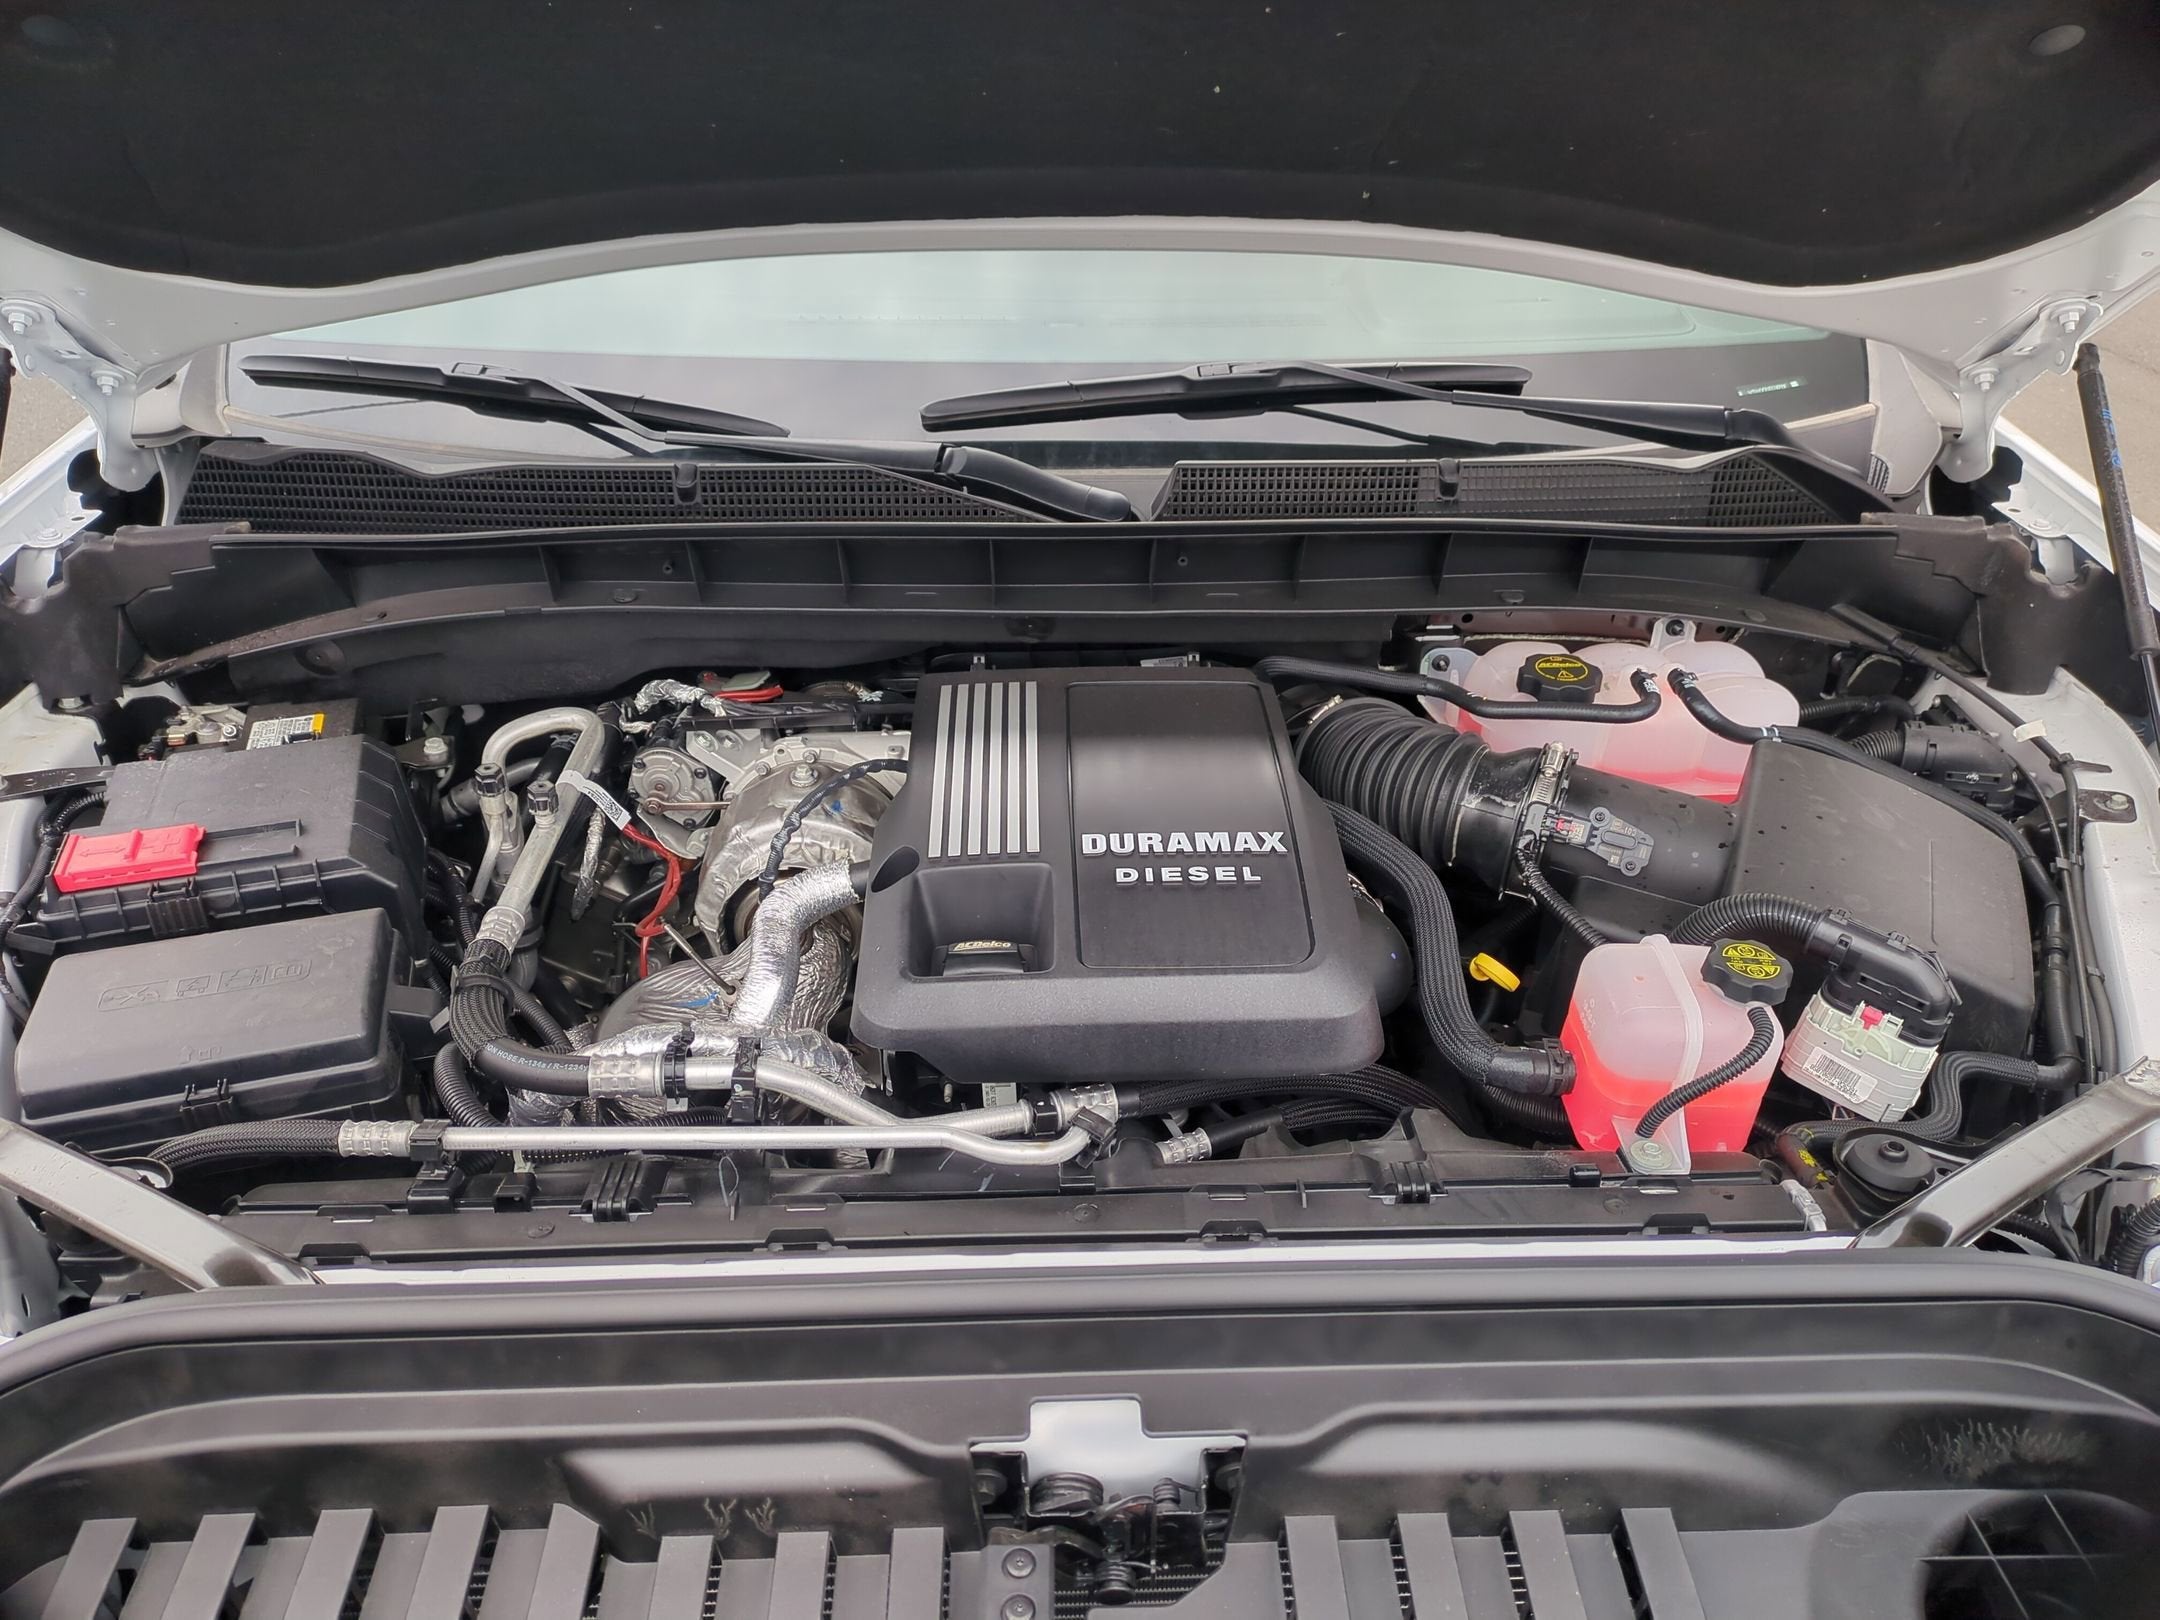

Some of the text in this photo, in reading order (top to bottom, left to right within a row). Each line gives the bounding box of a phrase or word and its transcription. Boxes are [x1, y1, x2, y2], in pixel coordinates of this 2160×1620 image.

[1081, 831, 1288, 855] DURAMAX
[1115, 866, 1262, 884] DIESEL
[952, 940, 1012, 952] ACDelco
[496, 1049, 518, 1063] HOSE
